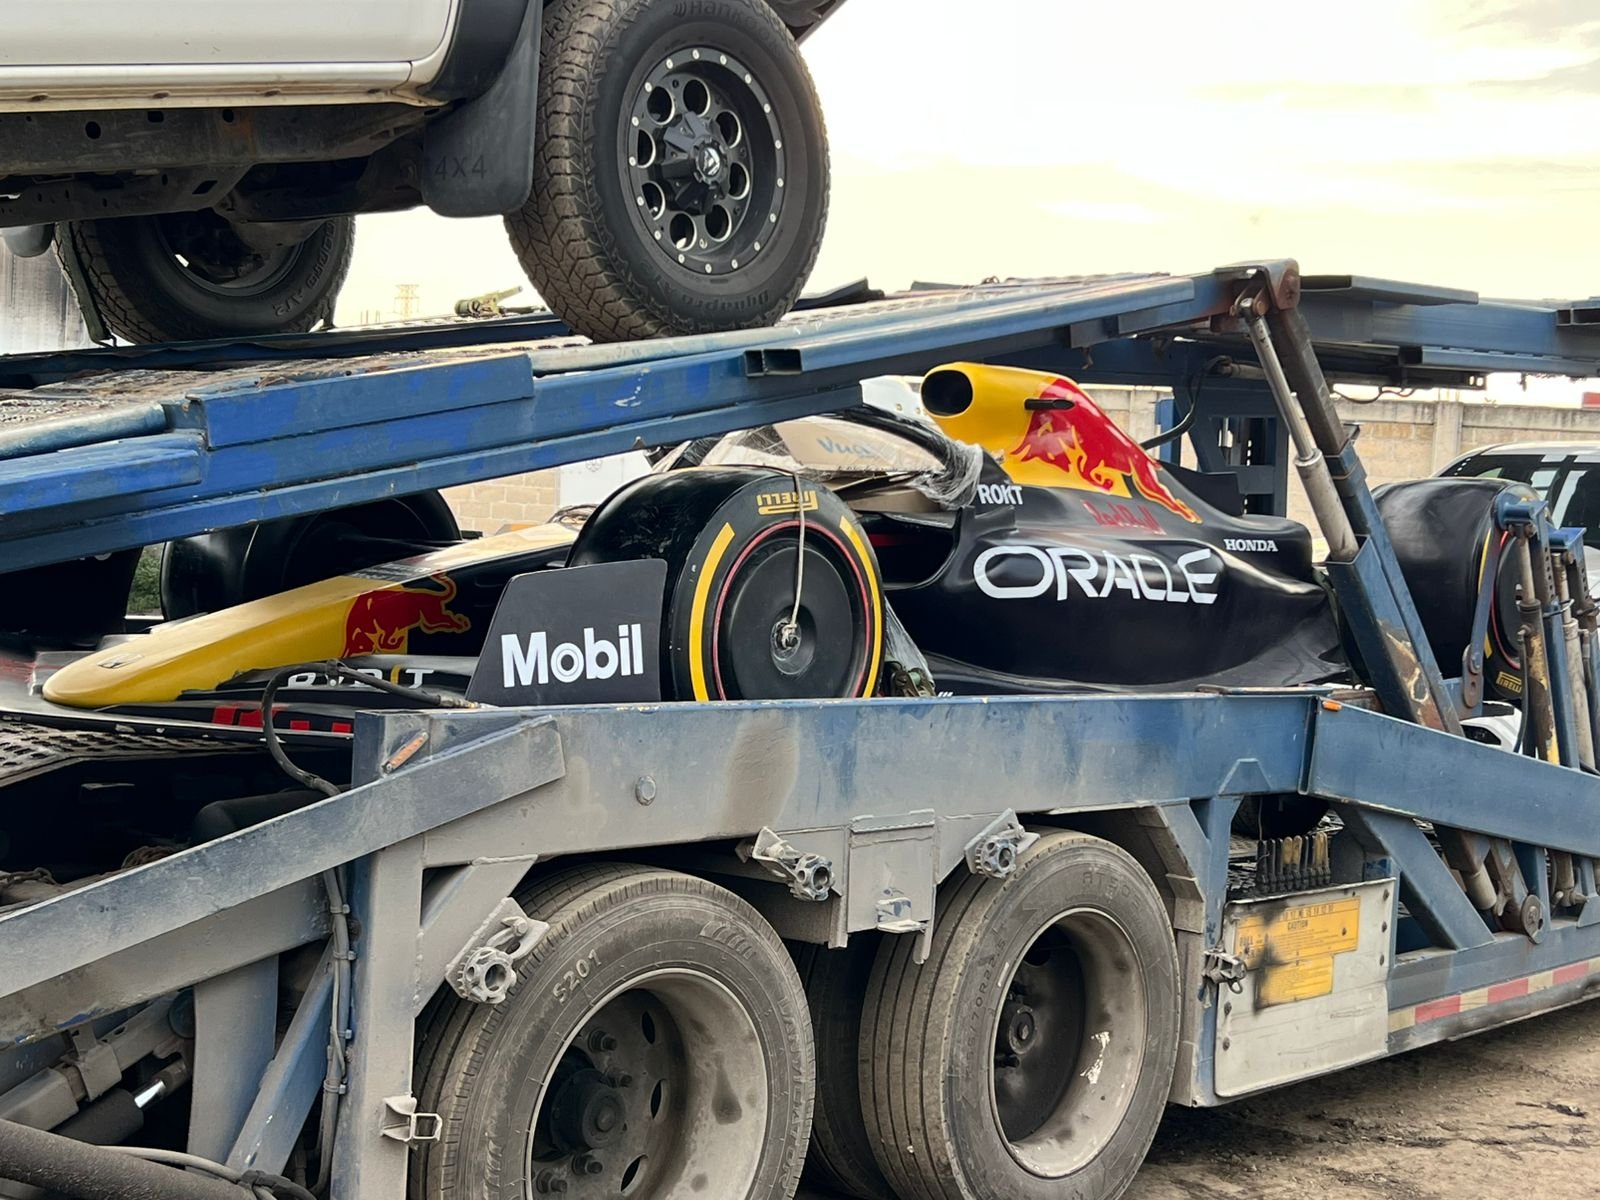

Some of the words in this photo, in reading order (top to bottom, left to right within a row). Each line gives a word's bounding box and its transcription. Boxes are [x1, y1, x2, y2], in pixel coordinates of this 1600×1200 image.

[977, 481, 1023, 505] ROKT
[1223, 538, 1279, 552] HONDA
[973, 545, 1218, 605] ORACLE
[501, 623, 644, 688] Mobil
[552, 948, 602, 1005] S201
